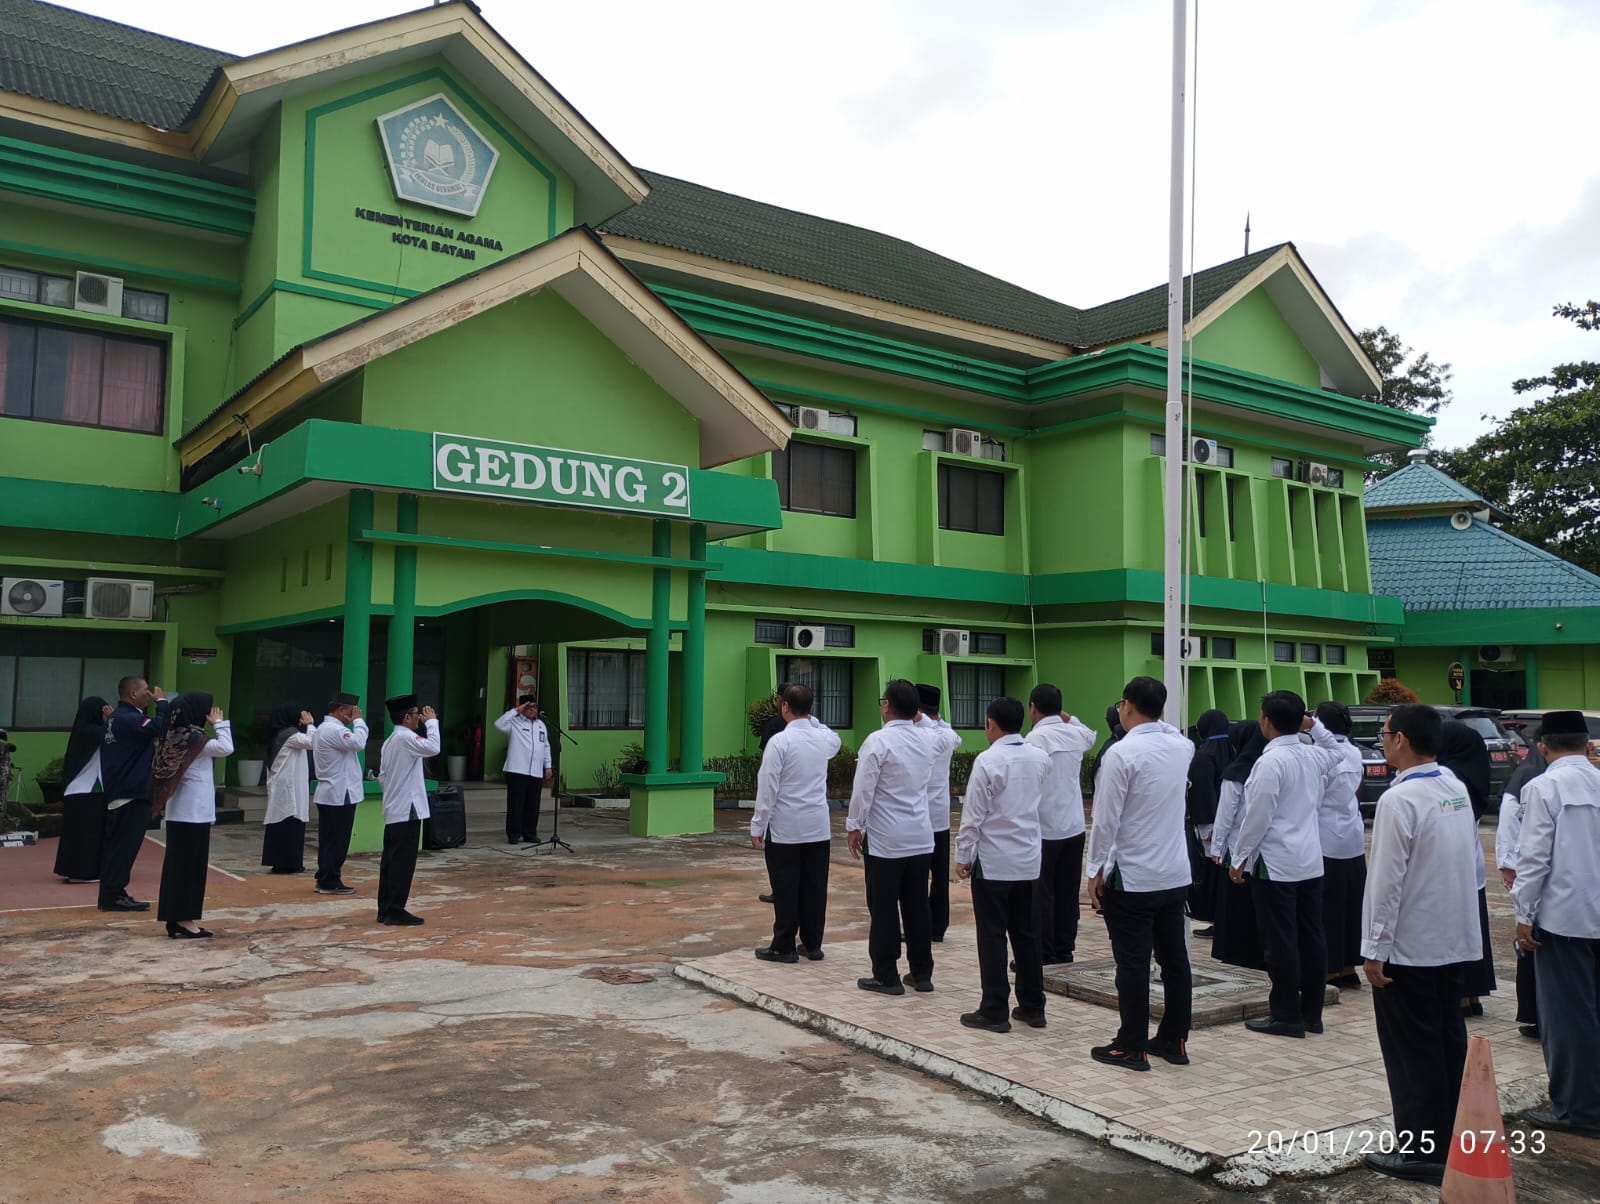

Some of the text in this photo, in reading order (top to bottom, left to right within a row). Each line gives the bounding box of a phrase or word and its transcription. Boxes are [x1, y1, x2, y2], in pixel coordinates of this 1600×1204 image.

[355, 207, 503, 251] KEMENTERIAN AGAMA
[392, 232, 476, 260] KOTA BATAM
[436, 443, 688, 508] GEDUNG 2
